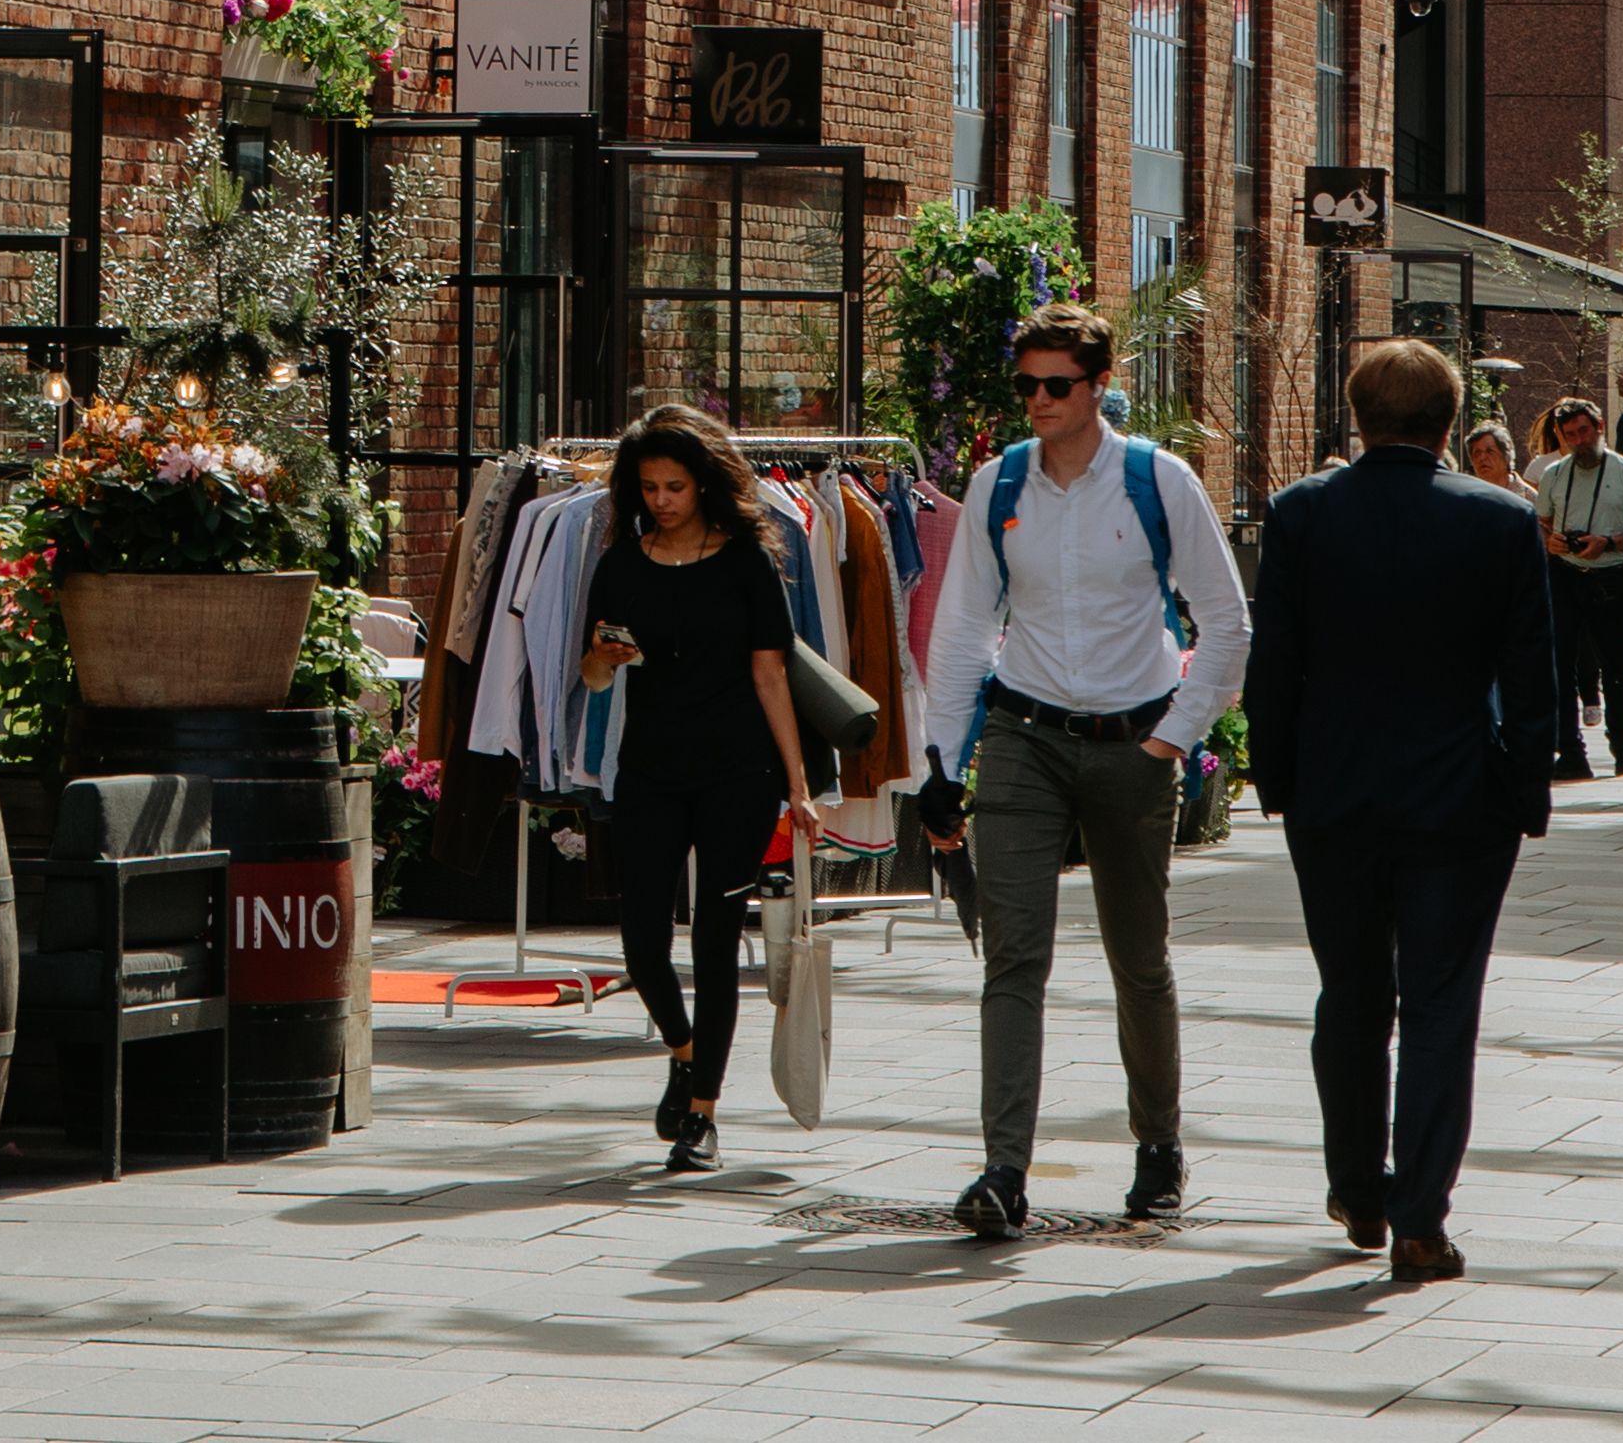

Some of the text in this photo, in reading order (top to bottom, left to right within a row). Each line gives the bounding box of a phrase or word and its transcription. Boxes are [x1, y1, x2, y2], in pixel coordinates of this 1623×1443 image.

[467, 38, 579, 72] VANITÉ
[524, 79, 534, 88] by
[207, 894, 340, 949] INIO
